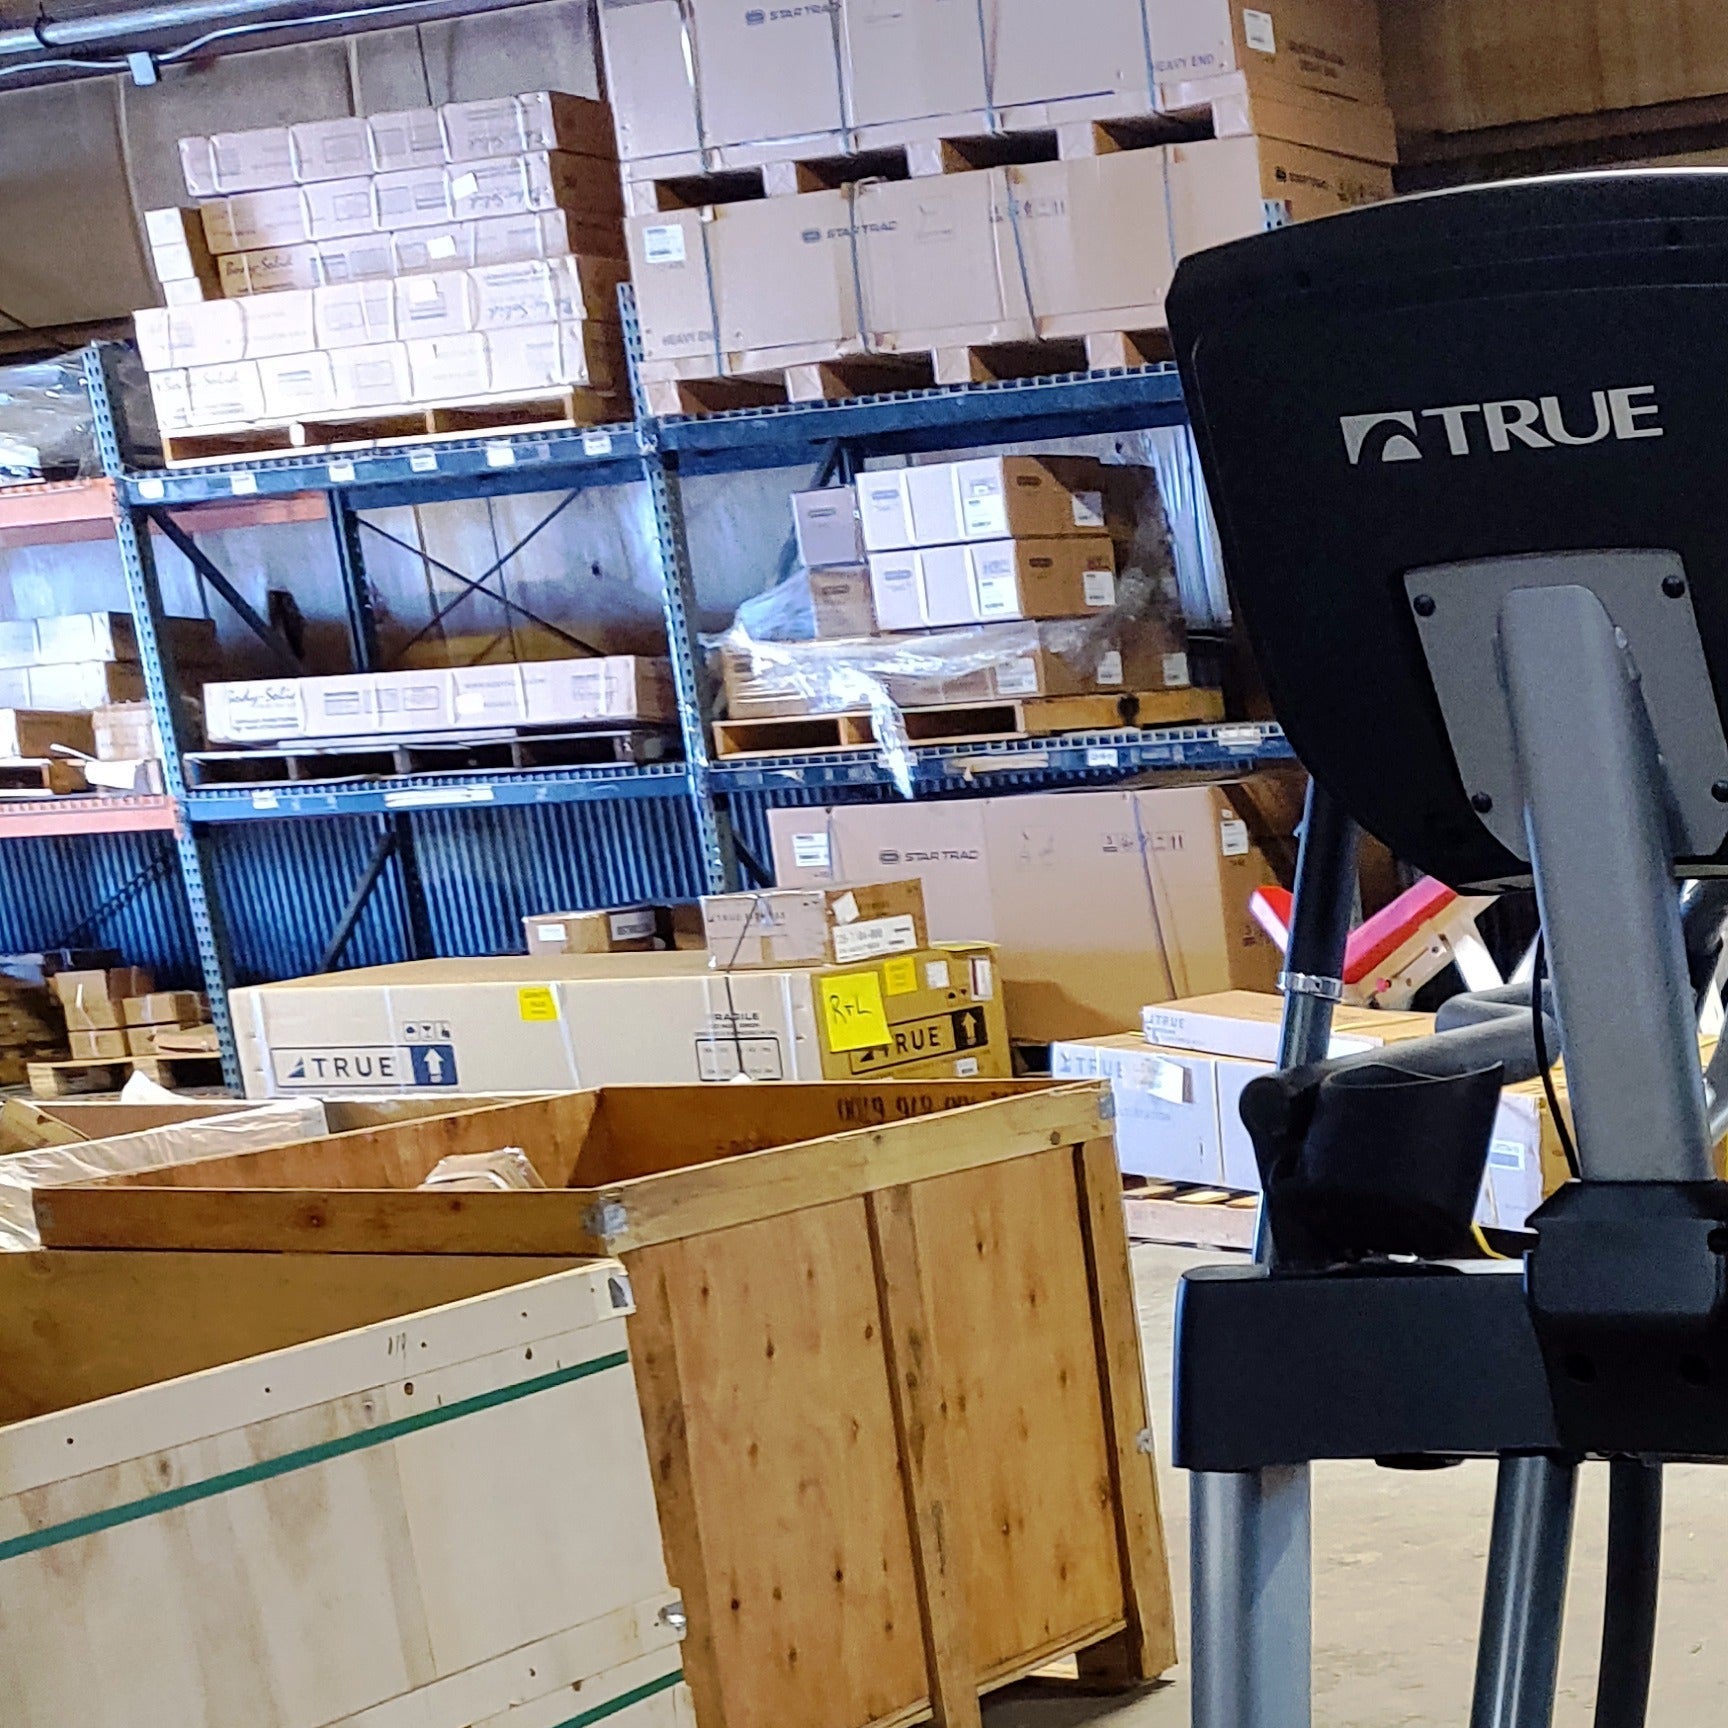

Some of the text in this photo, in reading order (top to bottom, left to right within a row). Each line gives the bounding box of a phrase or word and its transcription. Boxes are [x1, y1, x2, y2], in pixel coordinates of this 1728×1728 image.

[1191, 53, 1215, 67] END
[1421, 385, 1664, 456] TRUE
[904, 851, 939, 863] STAR
[312, 1056, 394, 1079] TRUE
